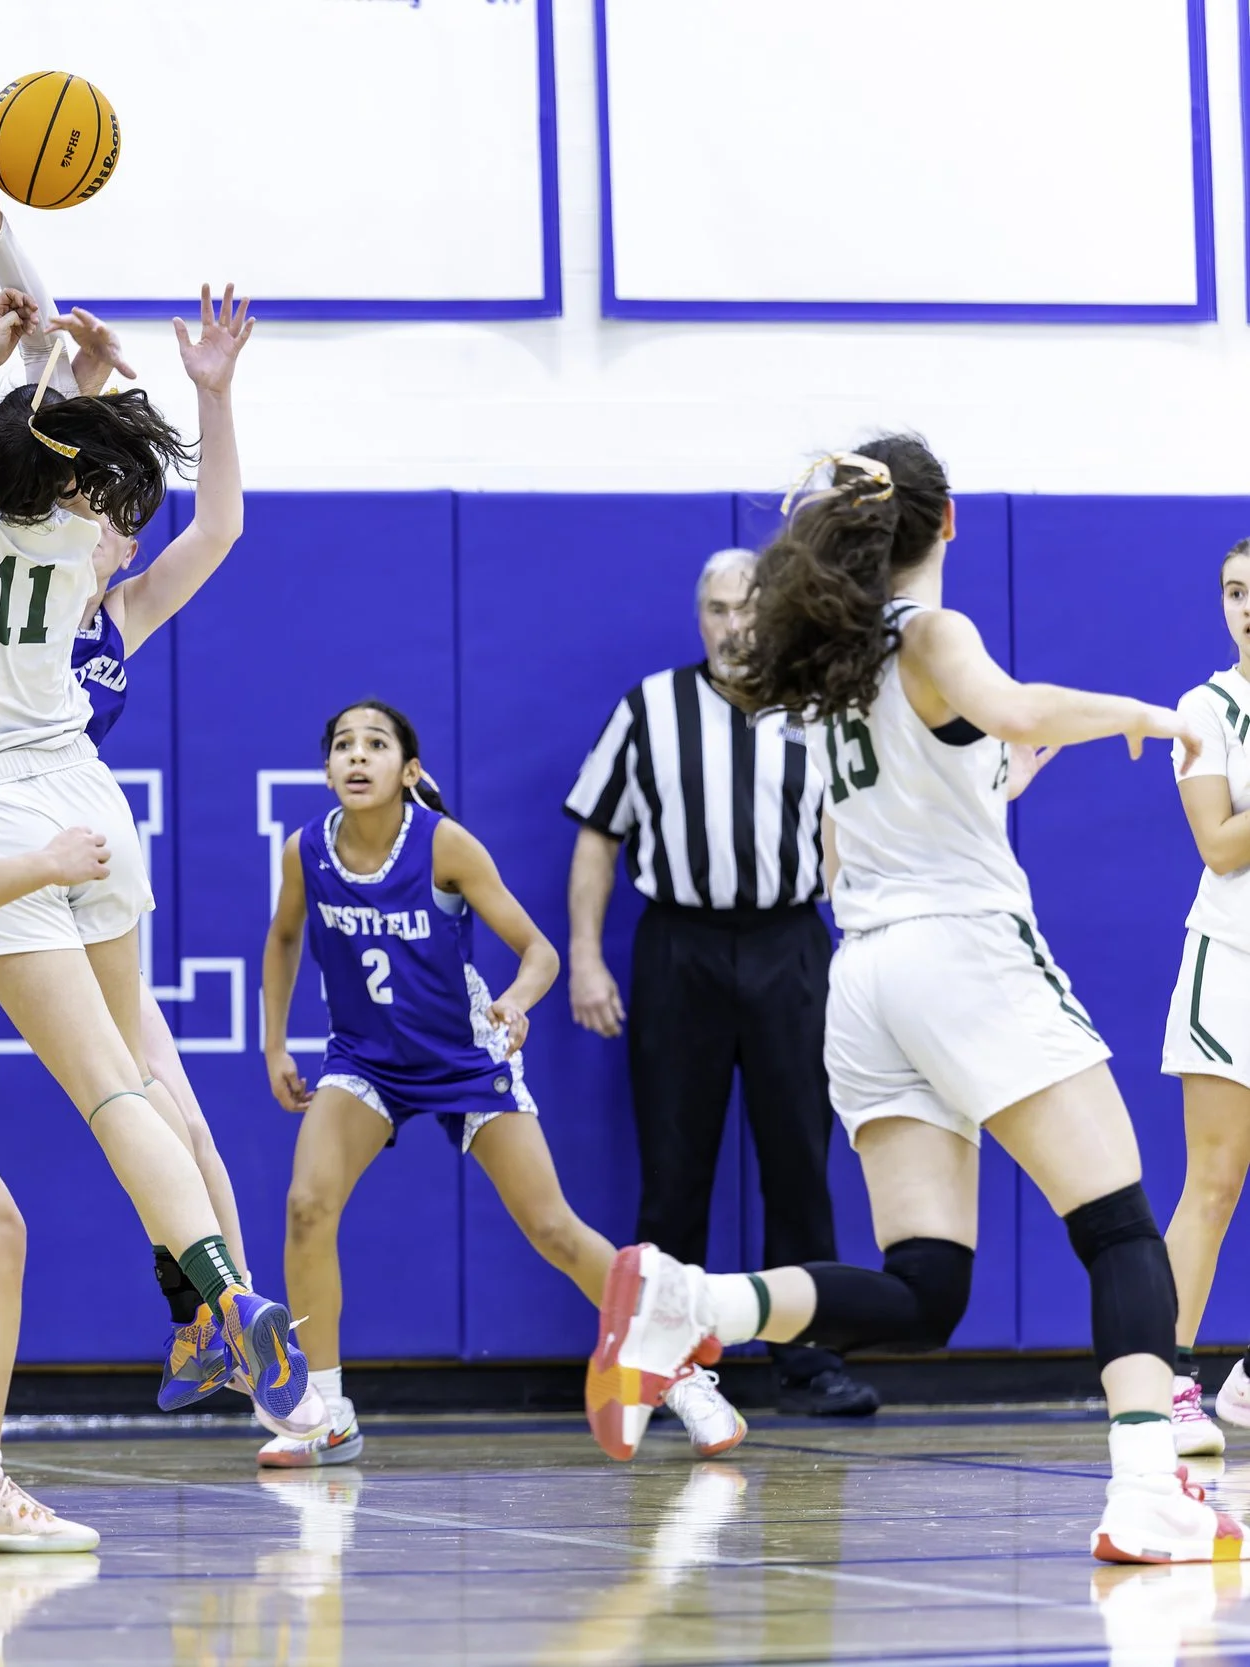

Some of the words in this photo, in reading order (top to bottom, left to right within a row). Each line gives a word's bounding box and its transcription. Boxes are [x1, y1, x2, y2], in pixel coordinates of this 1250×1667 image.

[63, 128, 81, 161] NFHS
[77, 113, 119, 199] Wilson
[823, 704, 880, 805] 15
[361, 948, 393, 1005] 2
